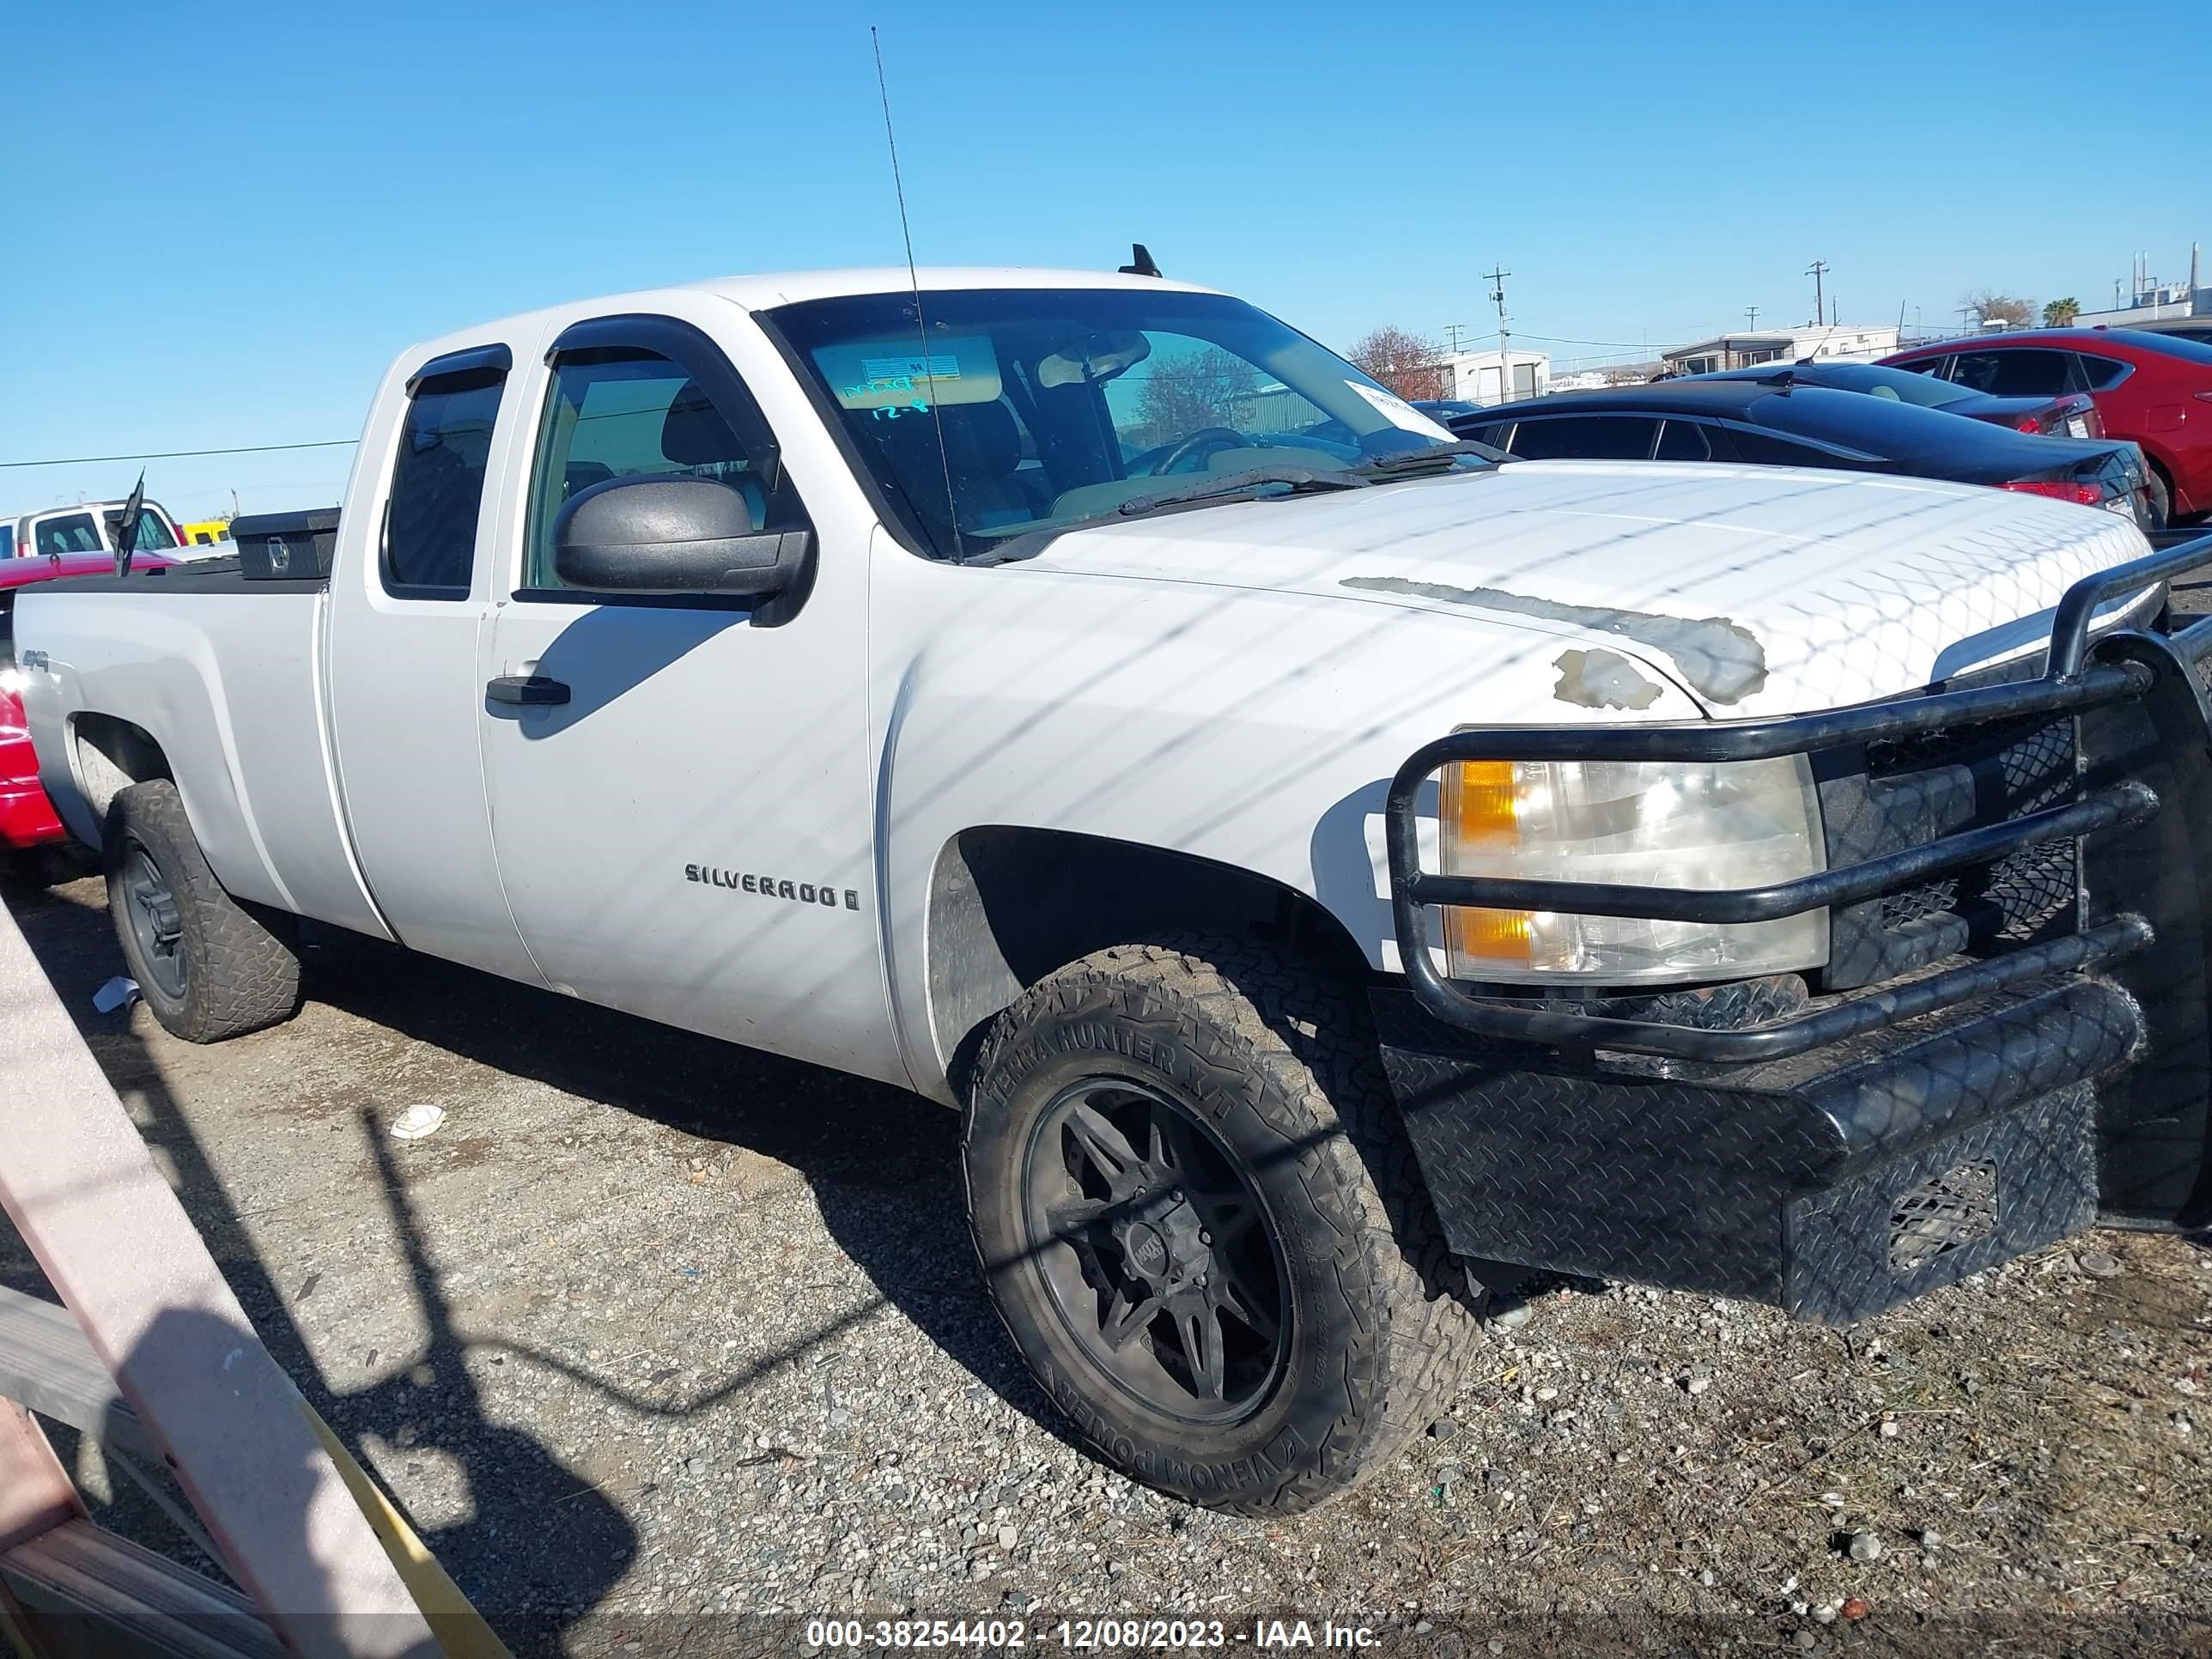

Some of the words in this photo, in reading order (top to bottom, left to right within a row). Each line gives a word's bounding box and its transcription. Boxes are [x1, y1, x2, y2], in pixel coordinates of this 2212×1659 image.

[872, 398, 929, 420] 12-8
[685, 864, 837, 907] SILVERADO
[988, 1032, 1057, 1107] TERRA
[1054, 1023, 1175, 1074] HUNTER
[1182, 1061, 1237, 1118] X/T
[1060, 1380, 1156, 1477] POWER
[1164, 1449, 1280, 1492] VENOM
